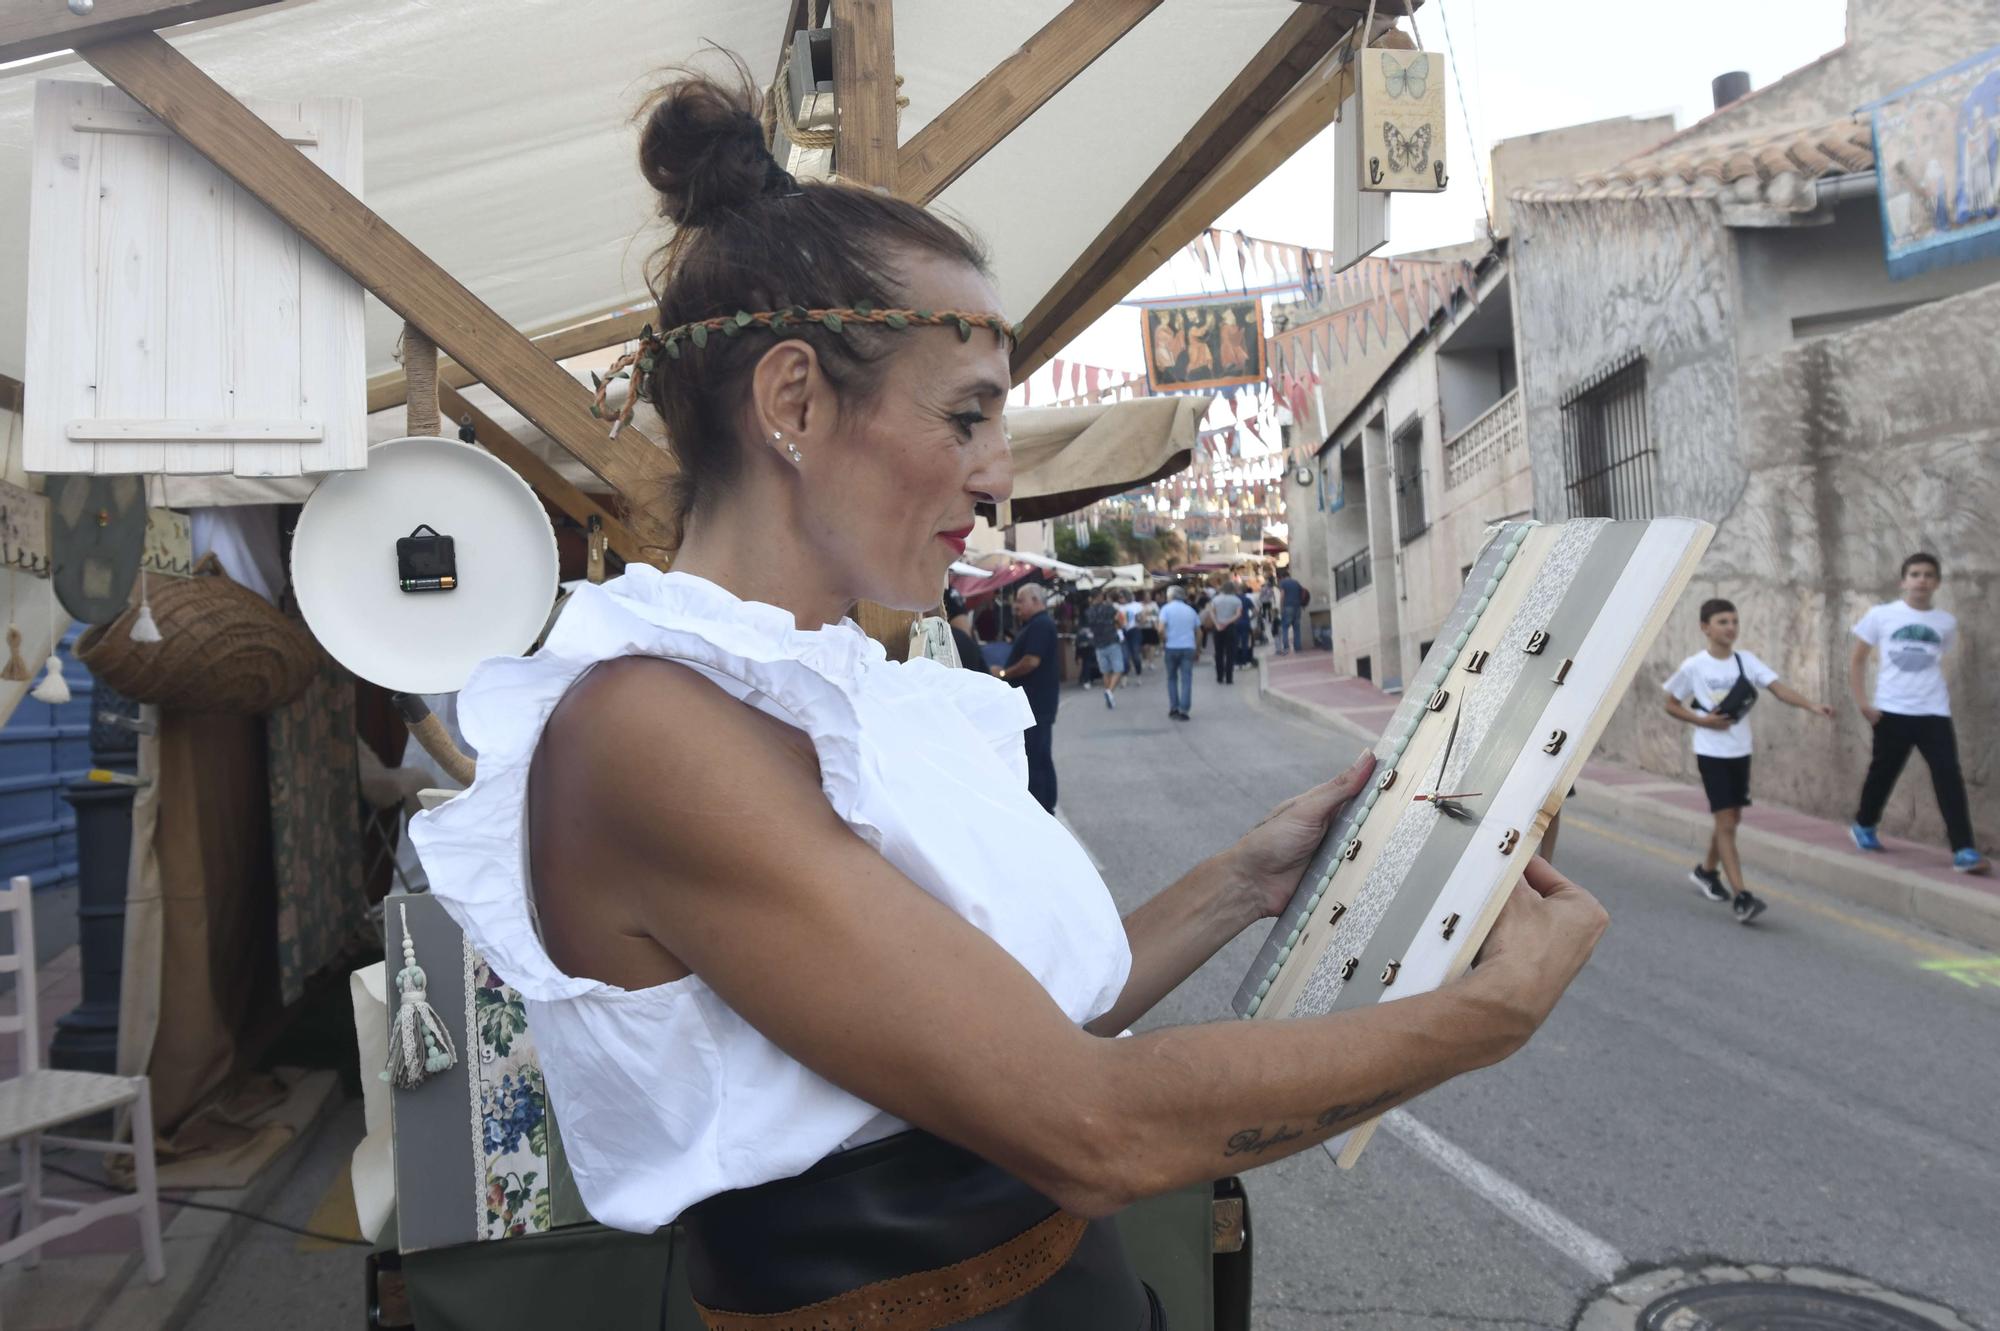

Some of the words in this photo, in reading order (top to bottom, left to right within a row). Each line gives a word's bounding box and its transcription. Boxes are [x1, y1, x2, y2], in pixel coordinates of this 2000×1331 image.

[1550, 658, 1573, 685] 1
[1543, 728, 1568, 756] 2
[1380, 767, 1398, 791] 9
[1344, 838, 1362, 861] 8
[1498, 827, 1520, 856] 3
[1329, 901, 1347, 926] 7
[1440, 911, 1461, 941] 4
[1341, 956, 1358, 981] 6
[1379, 958, 1401, 986] 5
[481, 1047, 496, 1065] 9
